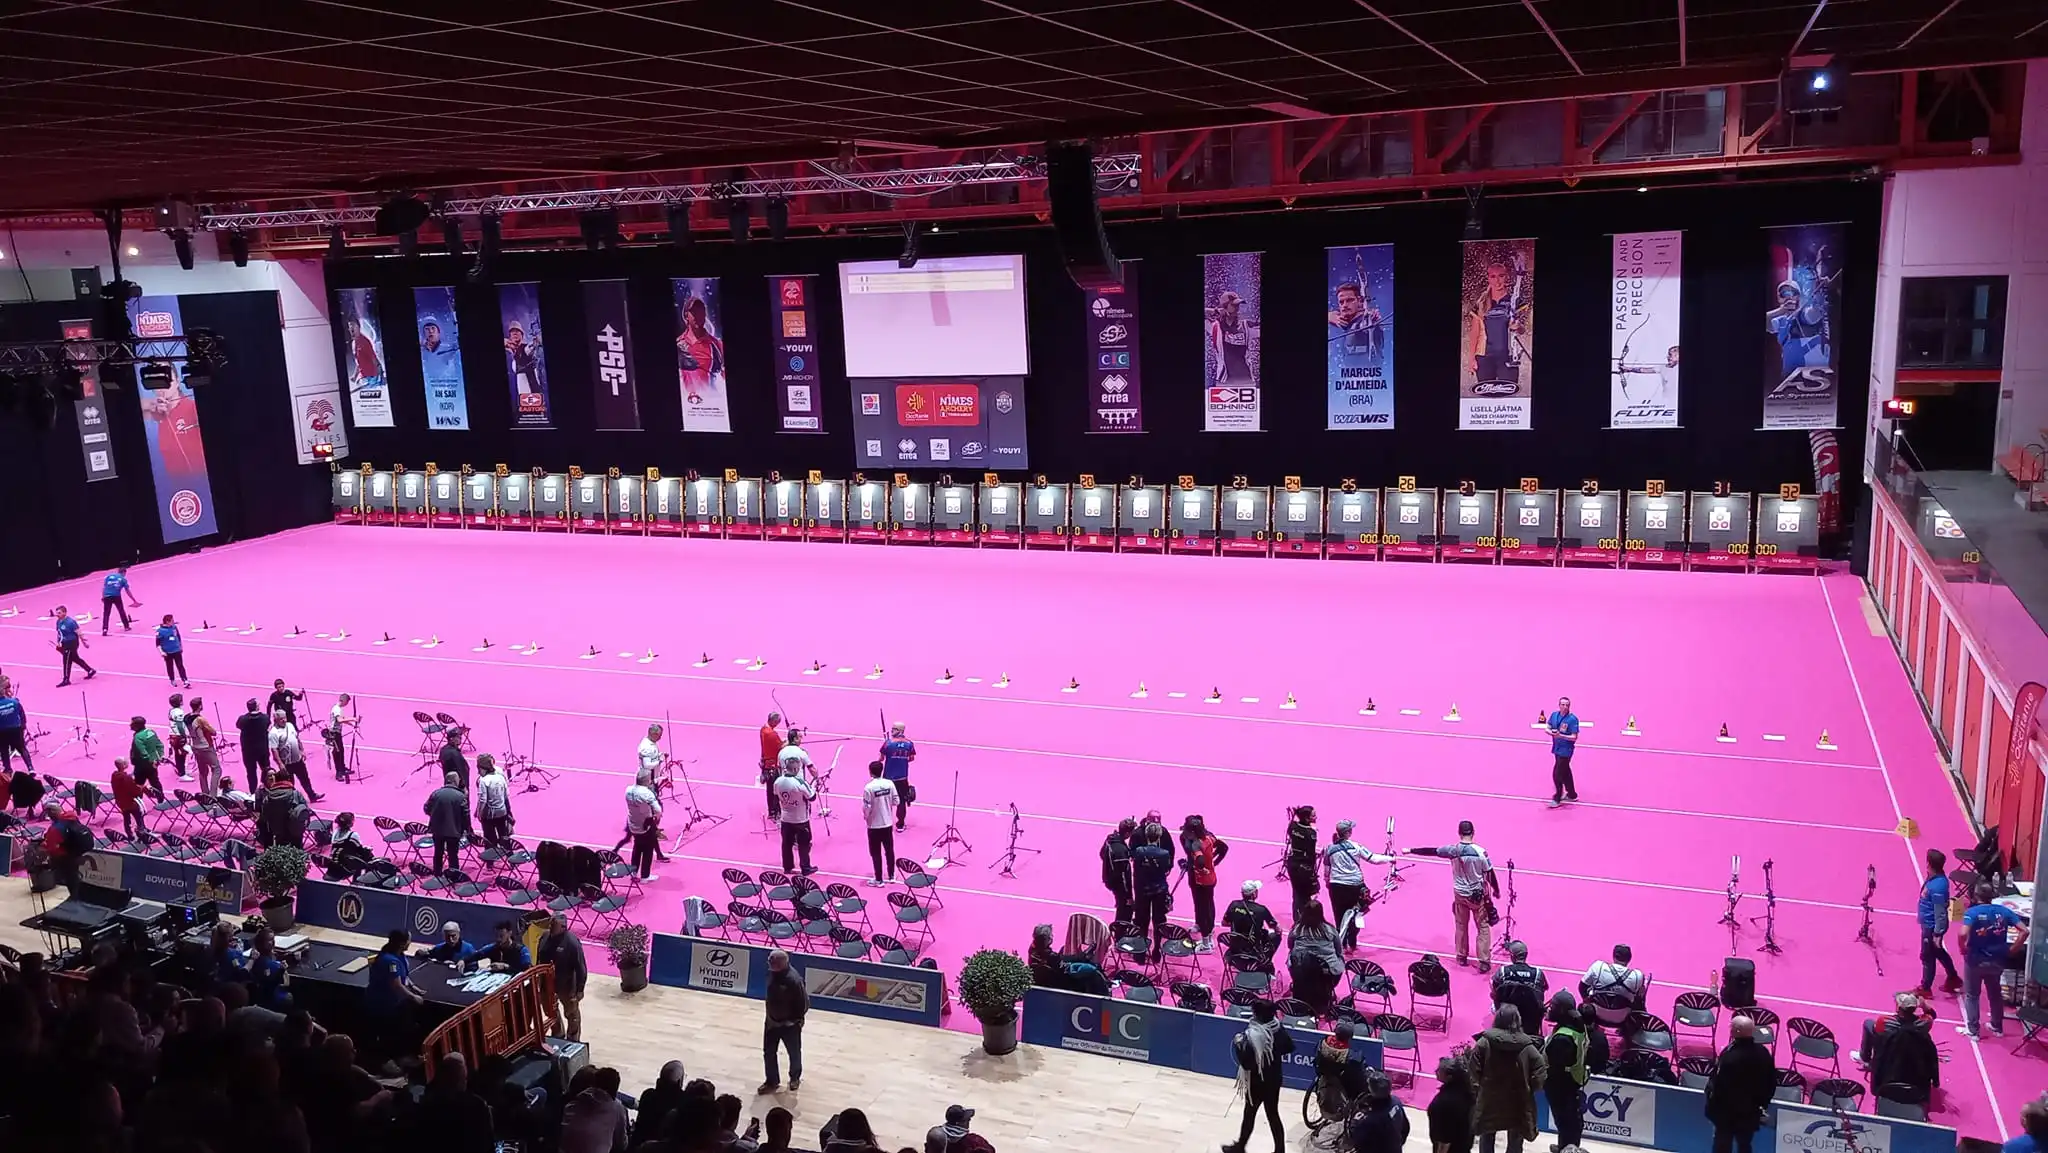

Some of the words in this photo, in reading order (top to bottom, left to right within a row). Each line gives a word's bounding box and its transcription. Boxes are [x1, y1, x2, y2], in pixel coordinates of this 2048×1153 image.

[1619, 239, 1628, 261] AND
[1631, 238, 1643, 316] PRECISION
[1615, 269, 1628, 330] PASSION
[597, 324, 628, 395] PSE
[1341, 367, 1383, 378] MARCUS
[1335, 379, 1388, 391] D'ALMEIDA
[939, 393, 974, 406] NÎMES
[1101, 393, 1129, 403] errea
[1348, 395, 1374, 407] (BRA)
[1471, 405, 1493, 413] LISELL
[1614, 409, 1677, 417] FLUTE
[436, 416, 461, 426] WNS
[1333, 414, 1390, 424] WIAWIS
[898, 452, 918, 460] errea
[331, 462, 340, 472] 01
[394, 464, 404, 473] 03
[462, 464, 472, 473] 05
[533, 466, 544, 476] 07
[609, 467, 620, 477] 09
[650, 469, 658, 480] 10
[728, 471, 736, 481] 12
[772, 471, 780, 481] 13
[813, 472, 821, 482] 14
[856, 472, 864, 483] 15
[899, 476, 907, 486] 16
[943, 475, 951, 486] 17
[989, 476, 998, 486] 18
[1037, 475, 1046, 486] 19
[1082, 476, 1094, 487] 20
[1130, 476, 1144, 487] 21
[1233, 476, 1248, 488] 23
[1286, 478, 1300, 490] 24
[1342, 478, 1356, 490] 25
[1400, 478, 1414, 490] 26
[1460, 480, 1476, 493] 27
[1522, 480, 1536, 492] 28
[1582, 480, 1598, 493] 29
[1648, 482, 1664, 495] 30
[1714, 481, 1730, 495] 31
[1782, 486, 1798, 498] 32
[354, 506, 358, 514] 0
[367, 506, 372, 514] 0
[418, 506, 423, 514] 0
[432, 507, 436, 515] 0
[487, 509, 492, 517] 0
[501, 510, 506, 518] 0
[558, 510, 563, 519] 0
[574, 511, 578, 520] 0
[633, 514, 638, 522] 0
[649, 514, 654, 522] 0
[712, 516, 717, 524] 0
[728, 516, 732, 525] 0
[793, 518, 798, 528] 0
[809, 518, 814, 528] 0
[877, 521, 882, 530] 0
[894, 522, 898, 530] 0
[964, 523, 969, 532] 0
[982, 524, 987, 533] 0
[1056, 526, 1062, 535] 0
[1074, 526, 1080, 536] 0
[1153, 528, 1160, 538] 0
[1172, 529, 1178, 538] 0
[1257, 530, 1264, 540] 0
[1276, 532, 1283, 542] 0
[1360, 533, 1378, 544] 000
[1382, 534, 1400, 545] 000
[1477, 536, 1496, 548] 000
[1501, 538, 1520, 549] 008
[1599, 538, 1618, 549] 000
[1625, 539, 1645, 550] 000
[1728, 543, 1748, 555] 000
[1756, 544, 1777, 555] 000
[145, 874, 188, 888] BOWTECH
[699, 966, 739, 979] HYUNDAI
[703, 977, 734, 988] NIMES
[1071, 1006, 1142, 1041] CIC
